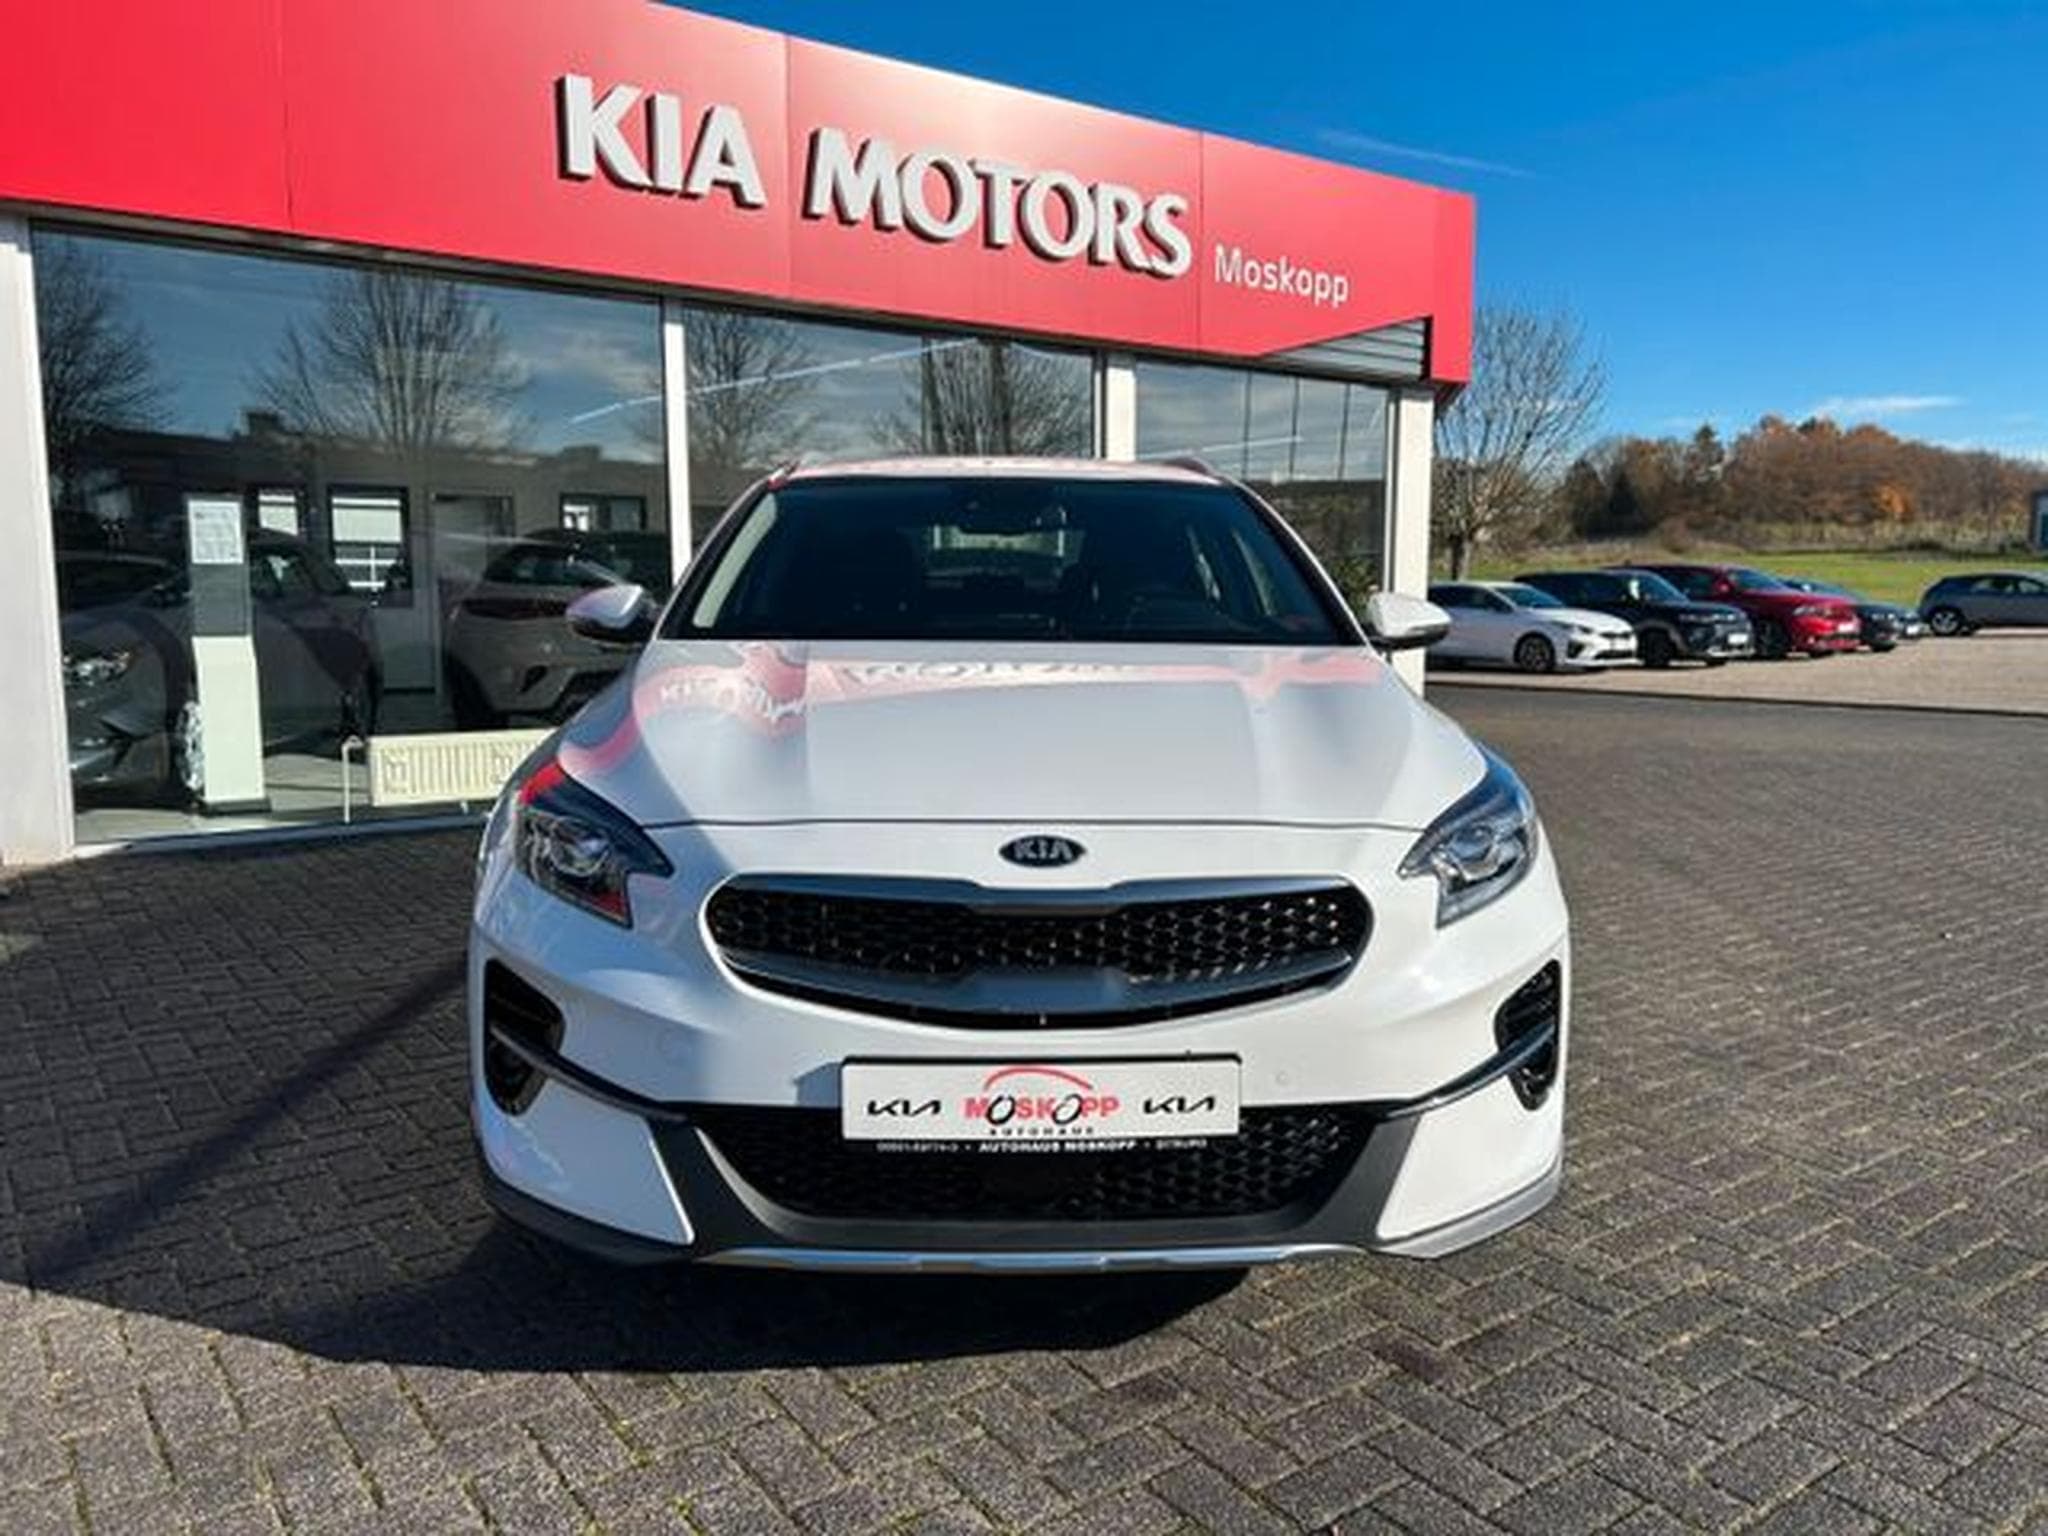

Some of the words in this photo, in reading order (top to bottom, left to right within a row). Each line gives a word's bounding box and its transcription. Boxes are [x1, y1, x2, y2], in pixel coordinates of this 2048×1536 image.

[557, 75, 765, 208] KIA
[803, 128, 1194, 278] MOTORS
[1214, 243, 1349, 309] Moskopp
[1013, 839, 1073, 859] KIA
[867, 1098, 941, 1116] KIA
[962, 1093, 1119, 1125] MOSKOPP
[1143, 1095, 1215, 1115] KIA
